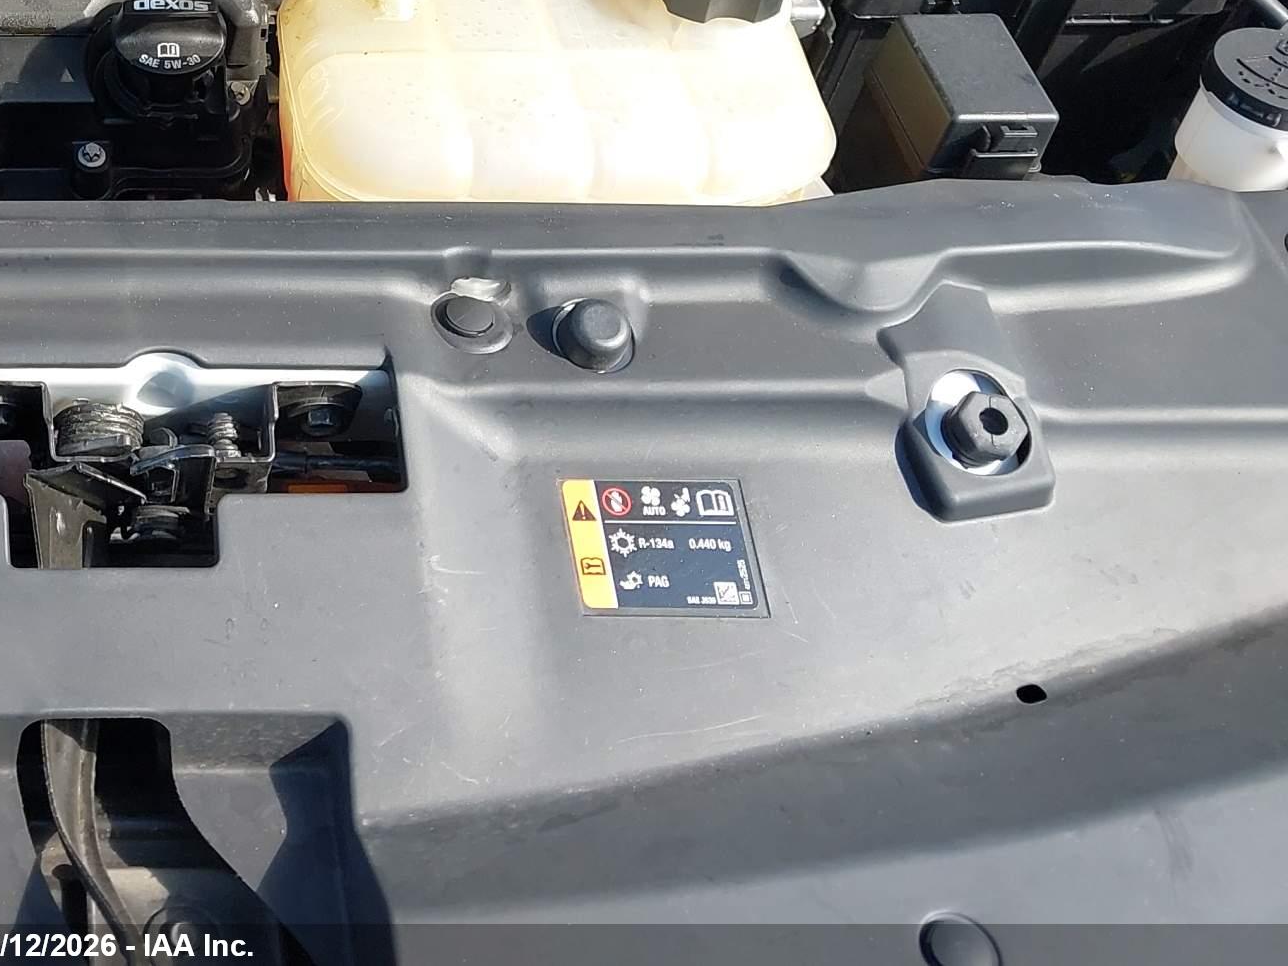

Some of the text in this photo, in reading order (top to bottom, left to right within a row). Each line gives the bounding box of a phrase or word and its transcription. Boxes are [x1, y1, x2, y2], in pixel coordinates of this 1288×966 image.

[138, 54, 201, 69] SAE 5W-30
[643, 506, 667, 516] AUTO
[638, 538, 732, 552] R-134a 0.440 kg
[647, 575, 669, 588] PAG
